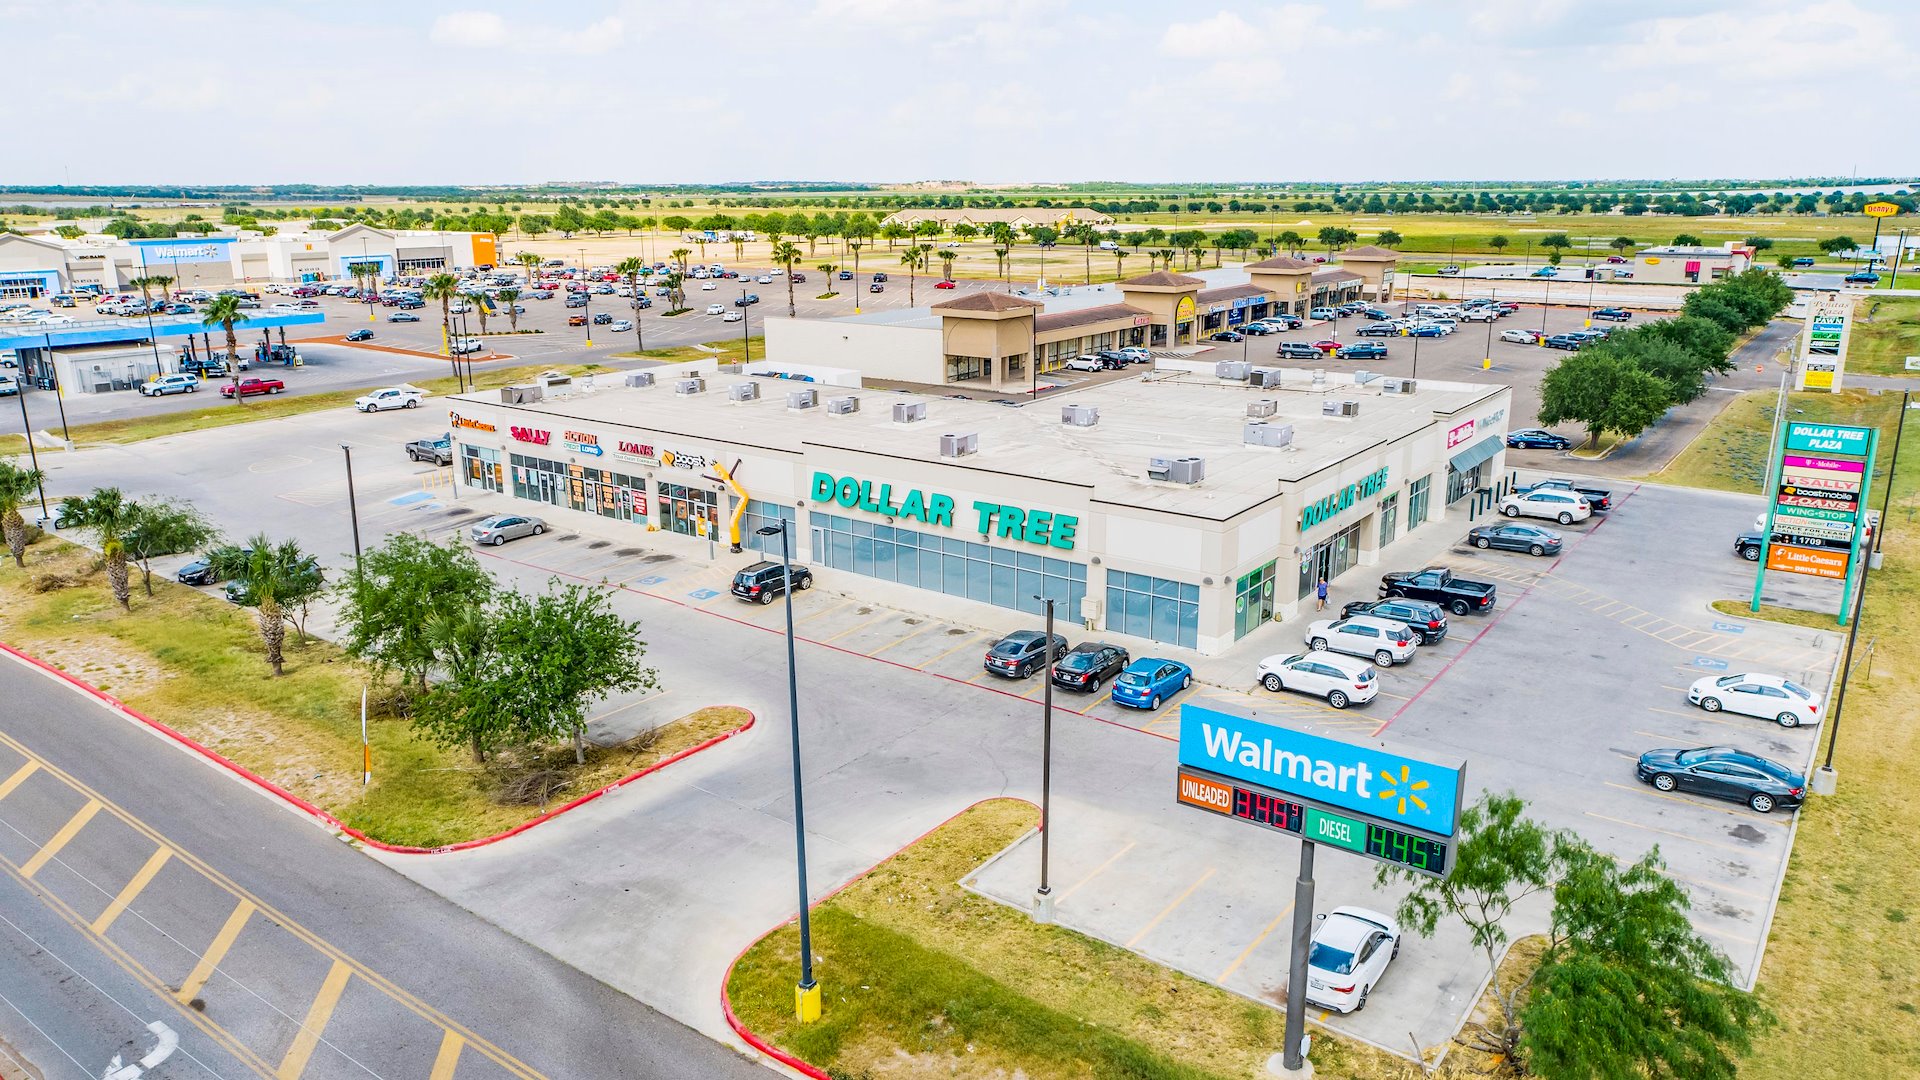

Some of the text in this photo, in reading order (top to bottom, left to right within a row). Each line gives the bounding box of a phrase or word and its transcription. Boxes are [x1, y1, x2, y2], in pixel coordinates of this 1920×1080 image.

[155, 246, 204, 258] Walmart
[510, 426, 550, 445] SALLY
[564, 431, 597, 444] ACTION
[1793, 427, 1865, 441] DOLLAR TREE
[618, 441, 654, 457] LOANS
[1808, 439, 1843, 450] PLAZA
[675, 451, 704, 467] boost
[1799, 477, 1855, 490] SALLY
[1301, 465, 1390, 532] DOLLAR TREE
[1785, 495, 1851, 509] LOANS
[811, 471, 1079, 550] DOLLAR TREE
[1799, 536, 1822, 546] 1709
[1787, 551, 1843, 567] Little Caesars
[1794, 565, 1841, 576] DRIVE THRU
[1202, 722, 1373, 799] Walmart
[1182, 779, 1230, 808] UNLEADED
[1237, 789, 1287, 829] 3.45
[1319, 818, 1352, 843] DIESEL
[1371, 824, 1428, 870] 4.45
